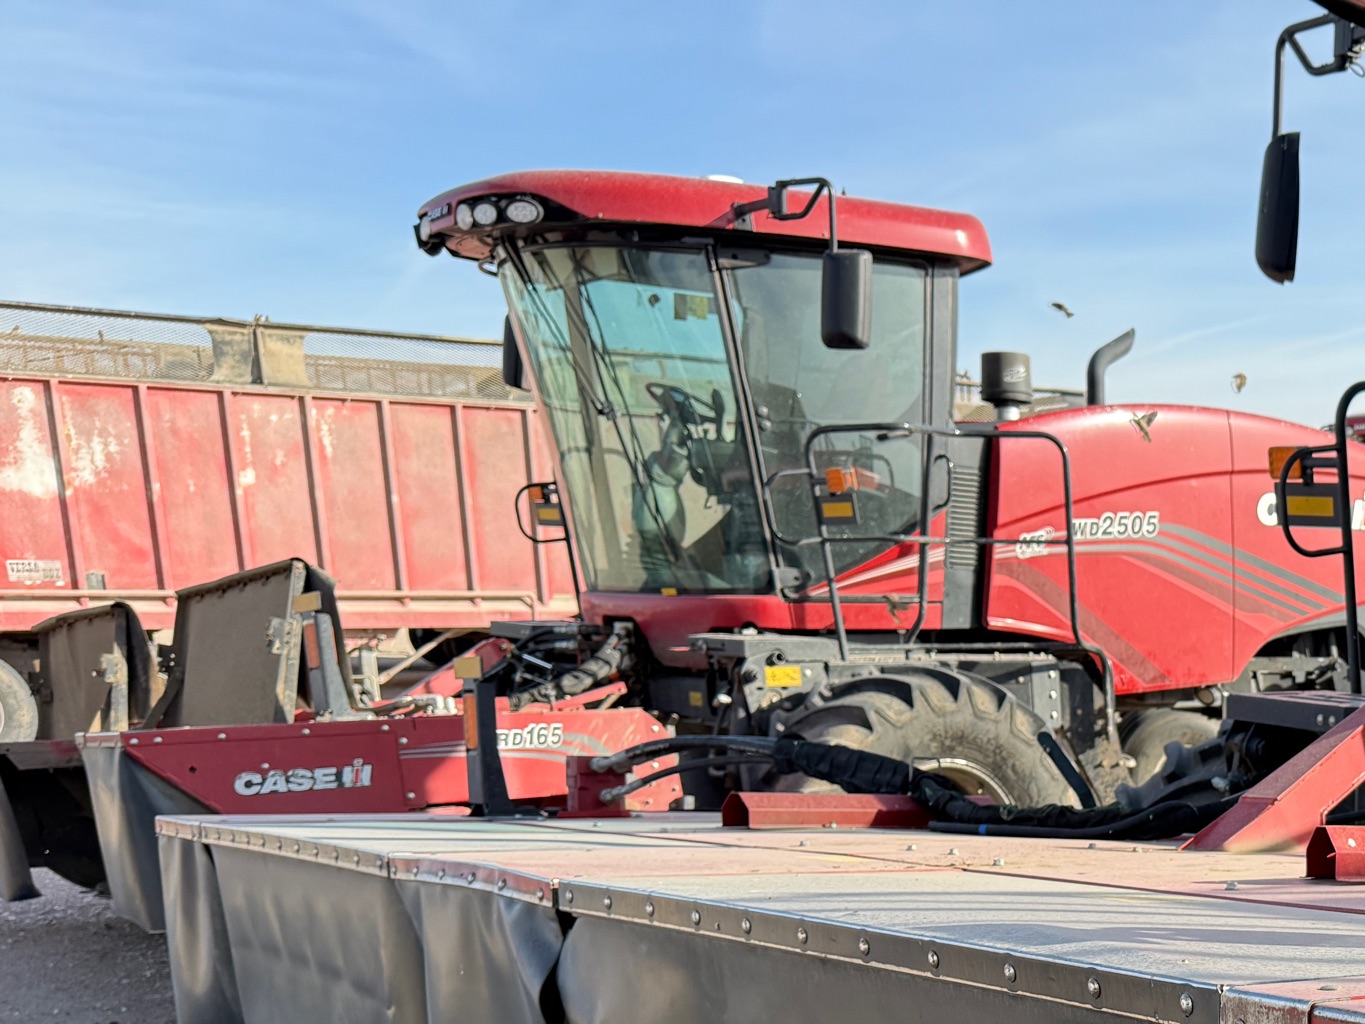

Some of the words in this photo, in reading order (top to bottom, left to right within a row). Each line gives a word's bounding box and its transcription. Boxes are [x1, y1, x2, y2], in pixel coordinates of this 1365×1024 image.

[1072, 511, 1160, 538] WD2505
[496, 722, 563, 750] RD165
[233, 766, 338, 796] CASE
